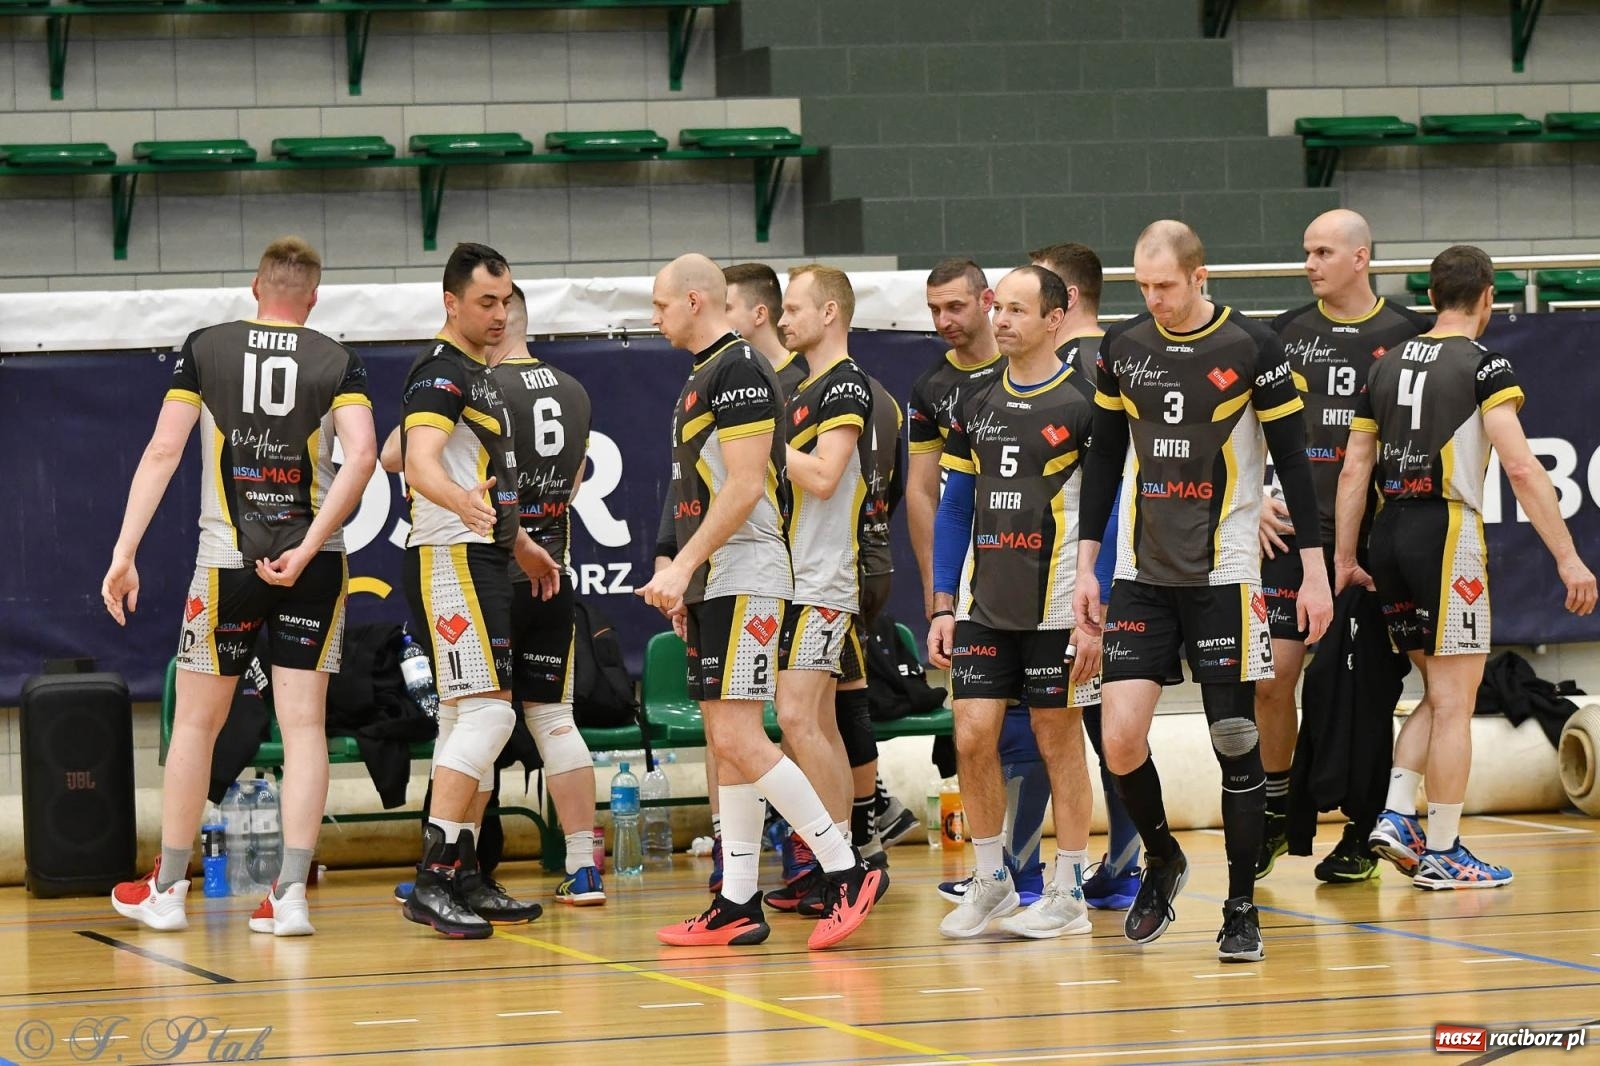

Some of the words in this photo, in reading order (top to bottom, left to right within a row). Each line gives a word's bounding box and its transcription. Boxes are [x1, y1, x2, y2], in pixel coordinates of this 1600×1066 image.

[248, 330, 298, 351] ENTER
[1401, 341, 1443, 364] ENTER
[242, 352, 298, 417] 10
[520, 368, 559, 390] ENTER
[1129, 354, 1168, 389] Hair
[1327, 366, 1356, 396] 13
[1163, 391, 1184, 424] 3
[1397, 368, 1428, 430] 4
[532, 396, 565, 457] 6
[975, 411, 1008, 445] Hair
[253, 428, 289, 460] Hair
[1153, 438, 1190, 458] ENTER
[1397, 439, 1429, 473] Hair
[1000, 445, 1020, 478] 5
[538, 465, 567, 497] Hair
[1142, 481, 1214, 500] STALMAG
[989, 491, 1022, 510] ENTER
[977, 531, 1042, 549] NSTALMAG
[1458, 578, 1475, 598] Enter
[279, 614, 320, 629] GRAVTON
[439, 620, 457, 637] Enter
[752, 620, 769, 638] Enter
[1463, 611, 1476, 640] 4
[822, 630, 833, 657] 7
[1197, 637, 1235, 648] GRAVTON
[1259, 631, 1272, 663] 3
[448, 651, 462, 680] 11
[753, 653, 768, 685] 2
